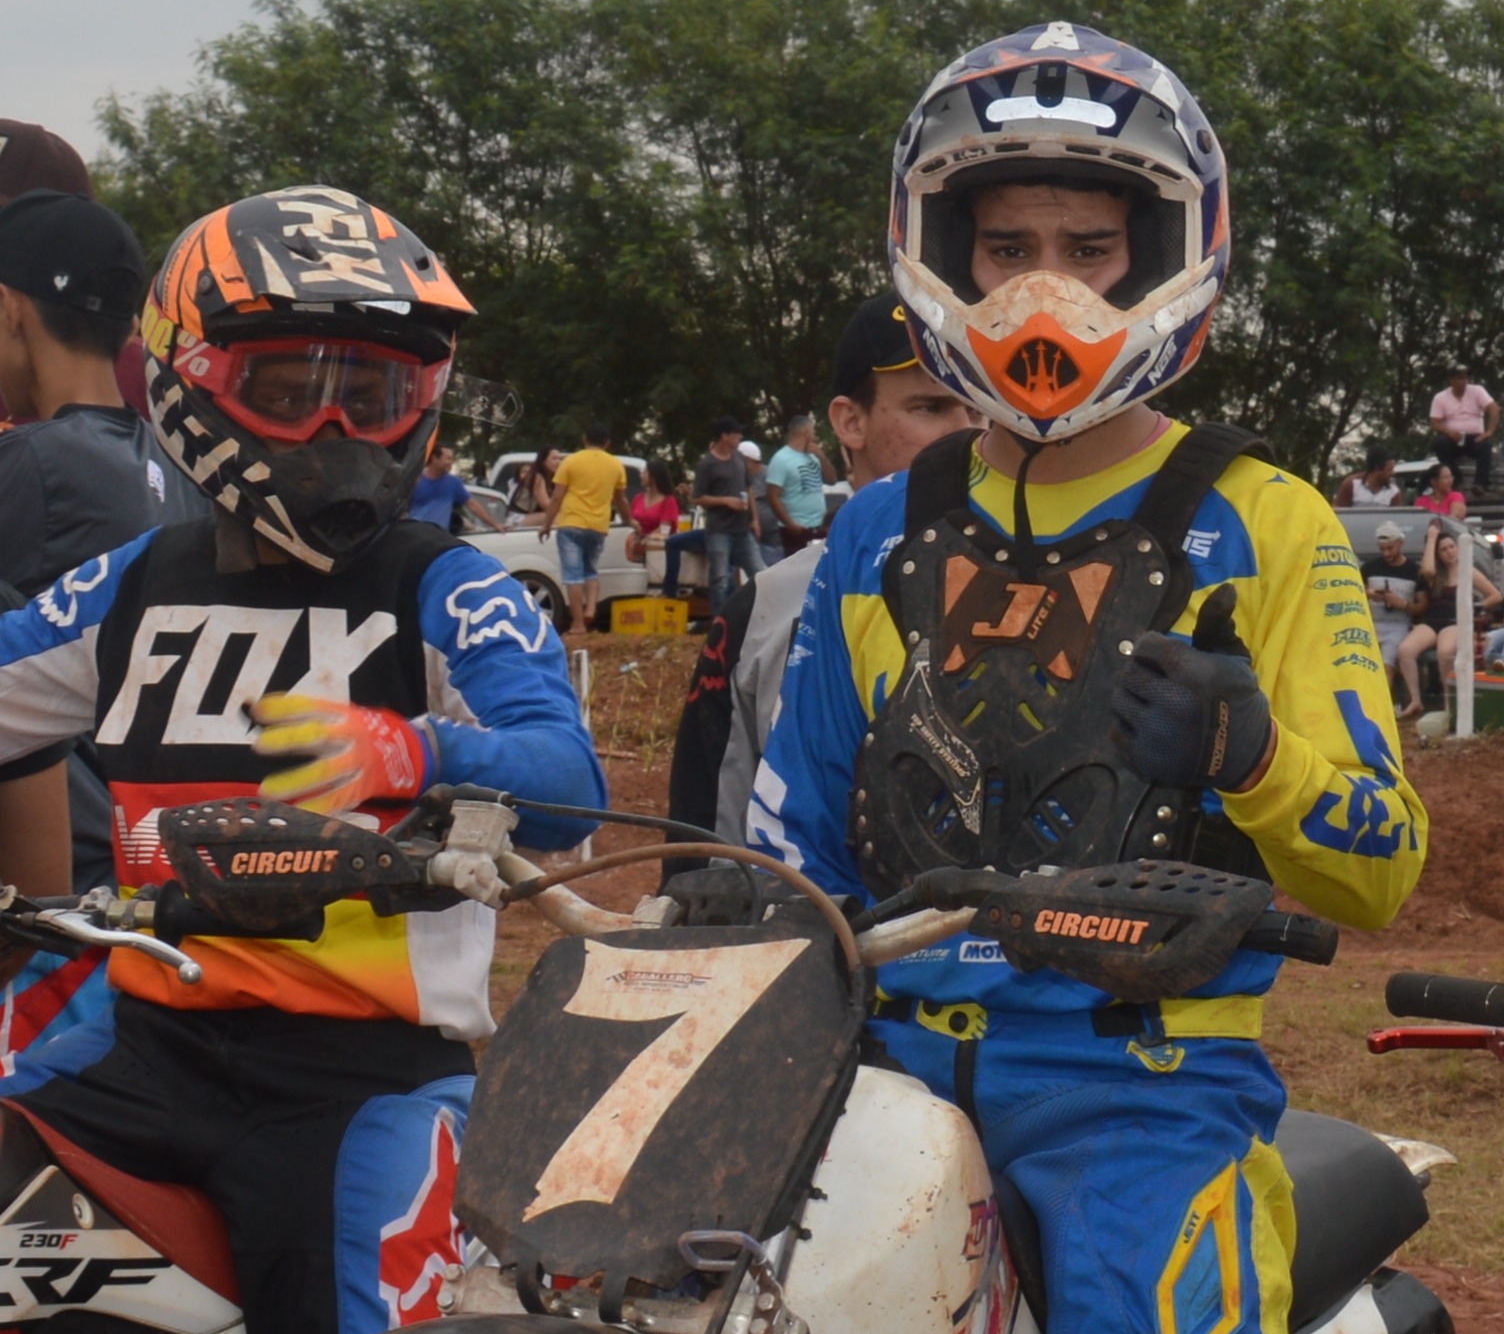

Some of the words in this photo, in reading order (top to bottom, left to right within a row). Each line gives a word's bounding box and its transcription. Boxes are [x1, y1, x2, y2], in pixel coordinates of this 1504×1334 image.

[96, 605, 397, 744] FOX
[231, 849, 340, 875] CIRCUIT
[1034, 909, 1149, 945] CIRCUIT
[522, 937, 812, 1223] 7
[19, 1233, 78, 1249] 230F
